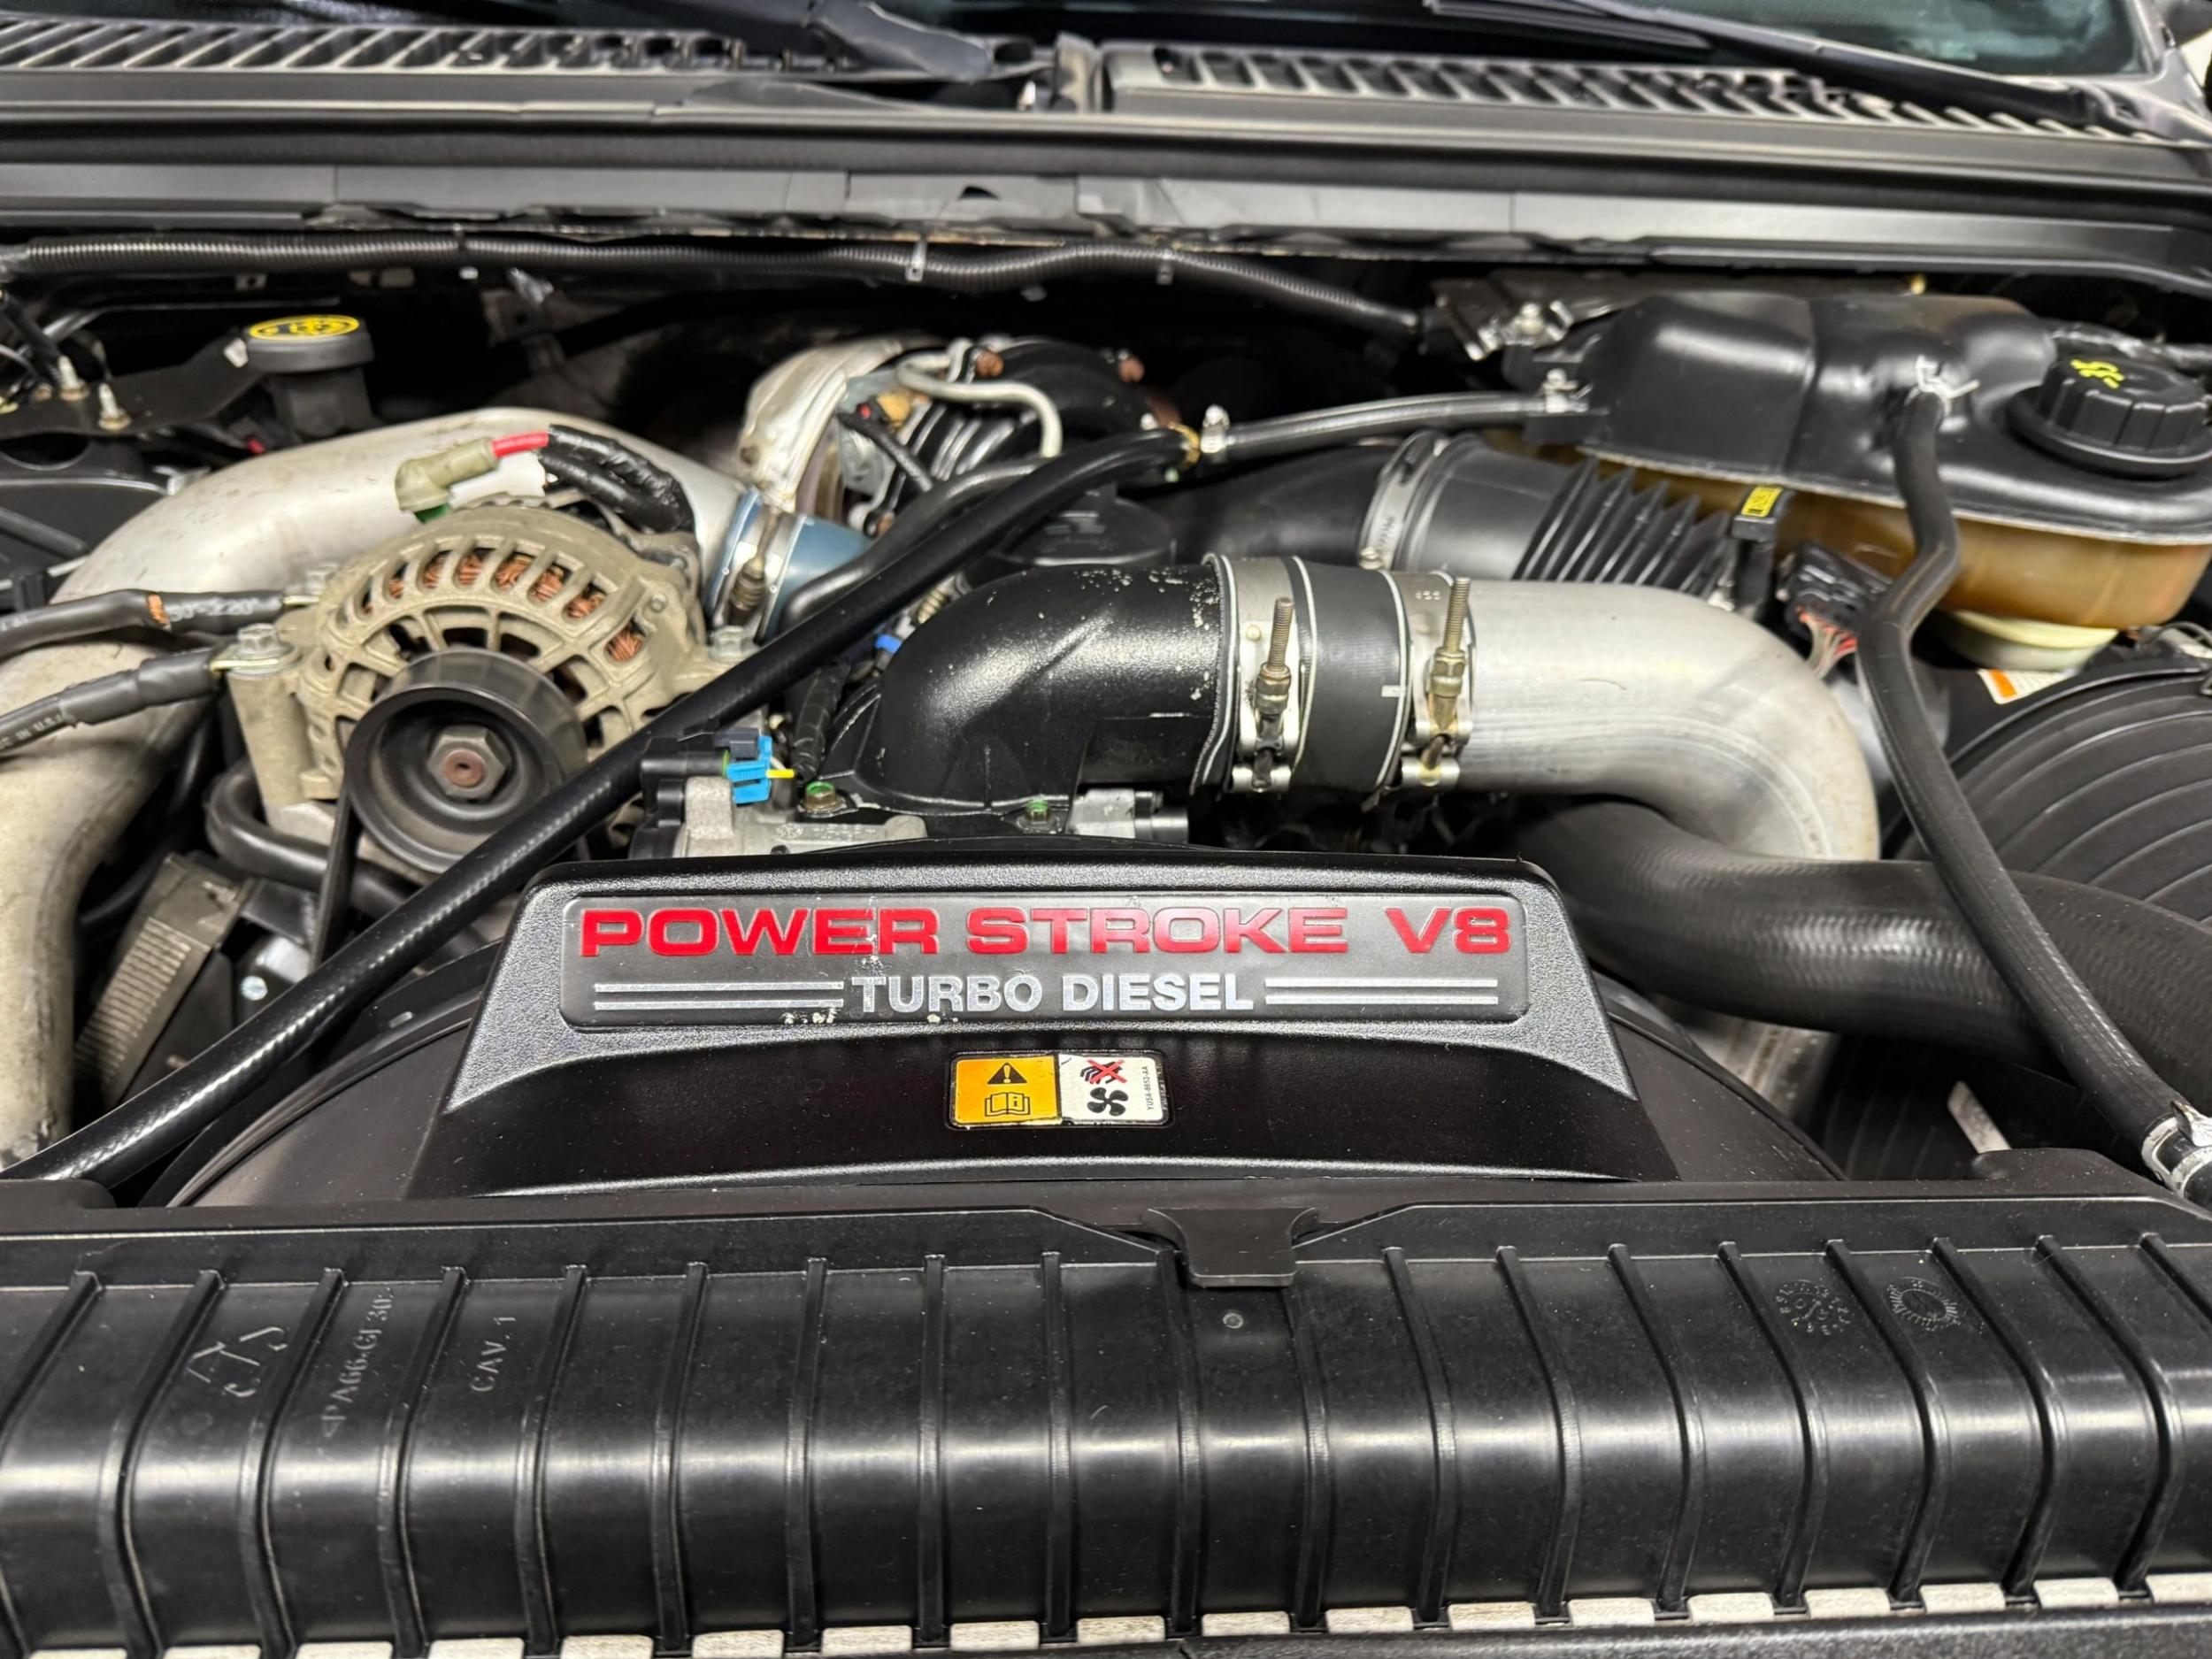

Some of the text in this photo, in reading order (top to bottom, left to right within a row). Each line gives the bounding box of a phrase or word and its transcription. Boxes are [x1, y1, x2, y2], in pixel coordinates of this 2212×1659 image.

[580, 907, 1511, 957] POWER STROKE V8
[851, 972, 1254, 1013] TURBO DIESEL
